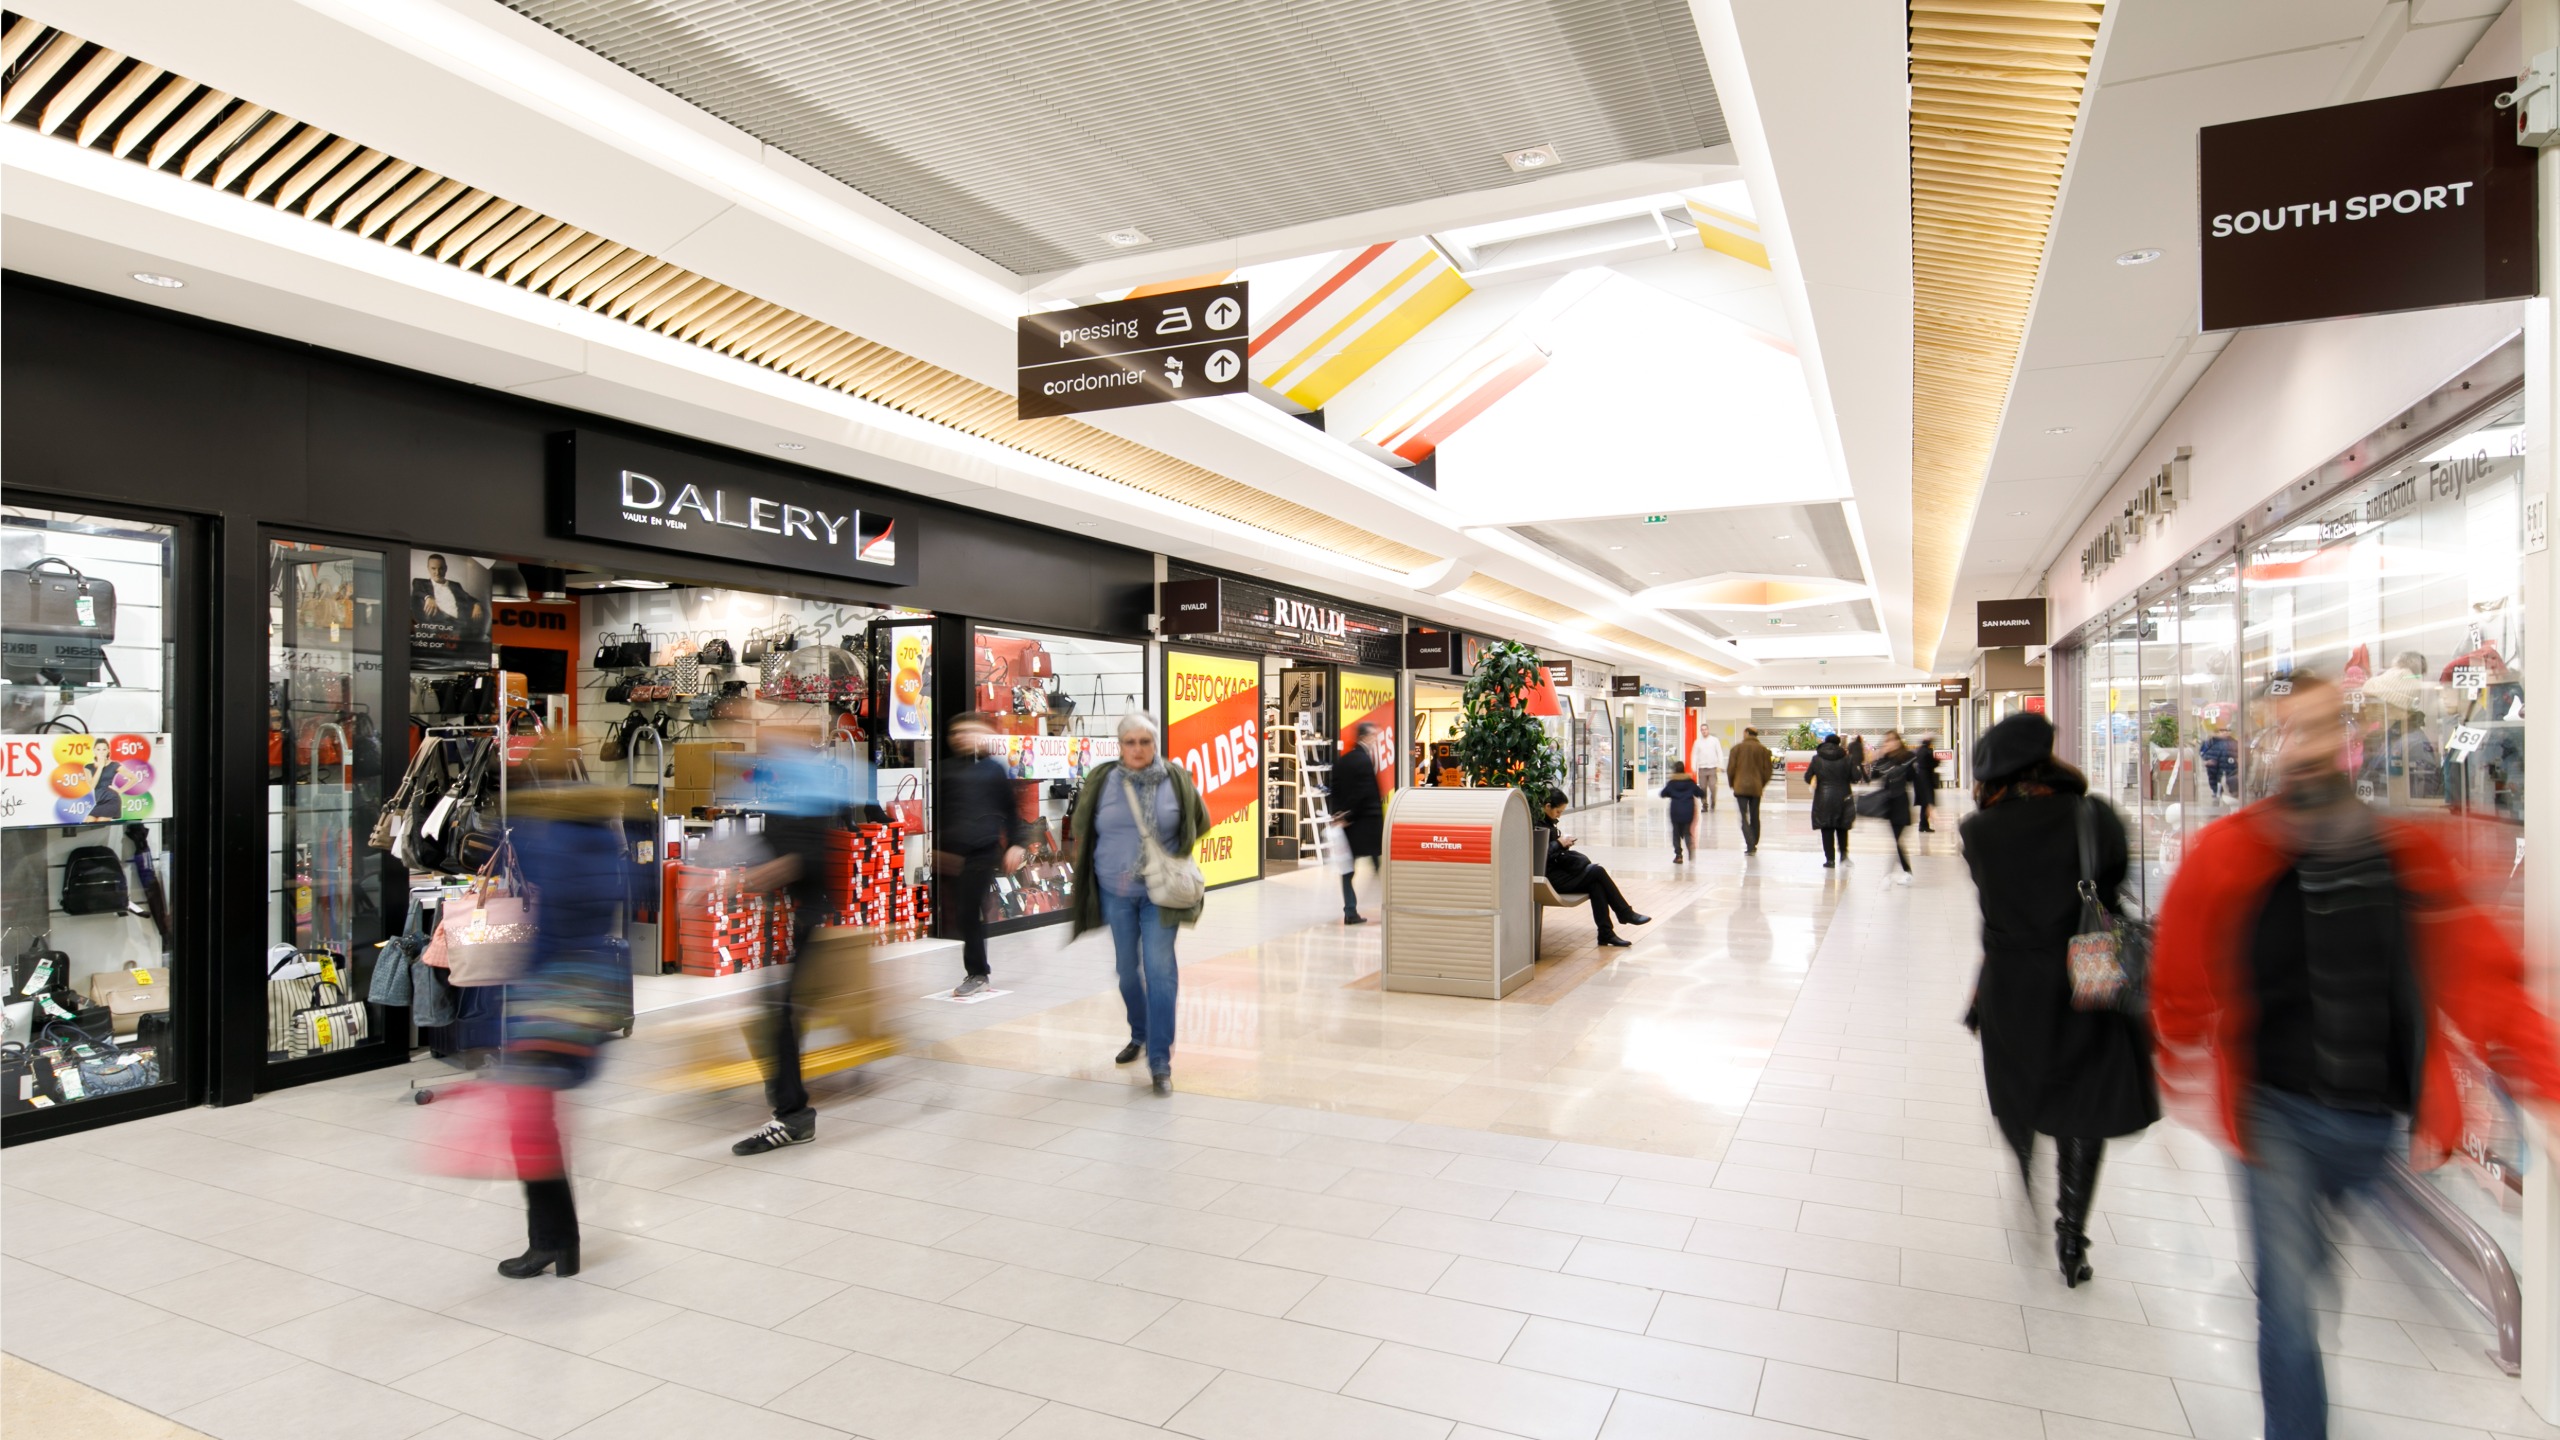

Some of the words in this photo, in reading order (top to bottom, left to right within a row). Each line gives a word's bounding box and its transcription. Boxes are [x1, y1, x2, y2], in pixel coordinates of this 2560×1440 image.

[2212, 200, 2337, 238] SOUTH
[2346, 181, 2474, 221] SPORT
[1060, 318, 1139, 348] pressing
[1043, 367, 1147, 396] cordonnier
[622, 470, 848, 545] DALERY
[2366, 475, 2417, 525] BIRKENSTOCK
[622, 511, 648, 523] VAULX
[650, 515, 663, 526] EN
[665, 517, 687, 531] VELIN
[1180, 602, 1208, 611] RIVALDI
[1274, 597, 1347, 638] RIVALDI
[1982, 620, 1999, 628] SAN
[1999, 618, 2031, 627] MARINA
[415, 632, 436, 640] pour
[421, 623, 454, 632] marque
[1300, 632, 1324, 647] JEANS
[2458, 730, 2481, 746] 69
[62, 742, 91, 756] -70%
[116, 742, 144, 756] -50%
[1040, 740, 1067, 757] SOLDES
[0, 741, 43, 778] ES
[56, 773, 87, 787] -30%
[2357, 785, 2372, 797] 69
[63, 800, 93, 815] -40%
[122, 798, 149, 812] -20%
[1200, 835, 1233, 864] HIVER
